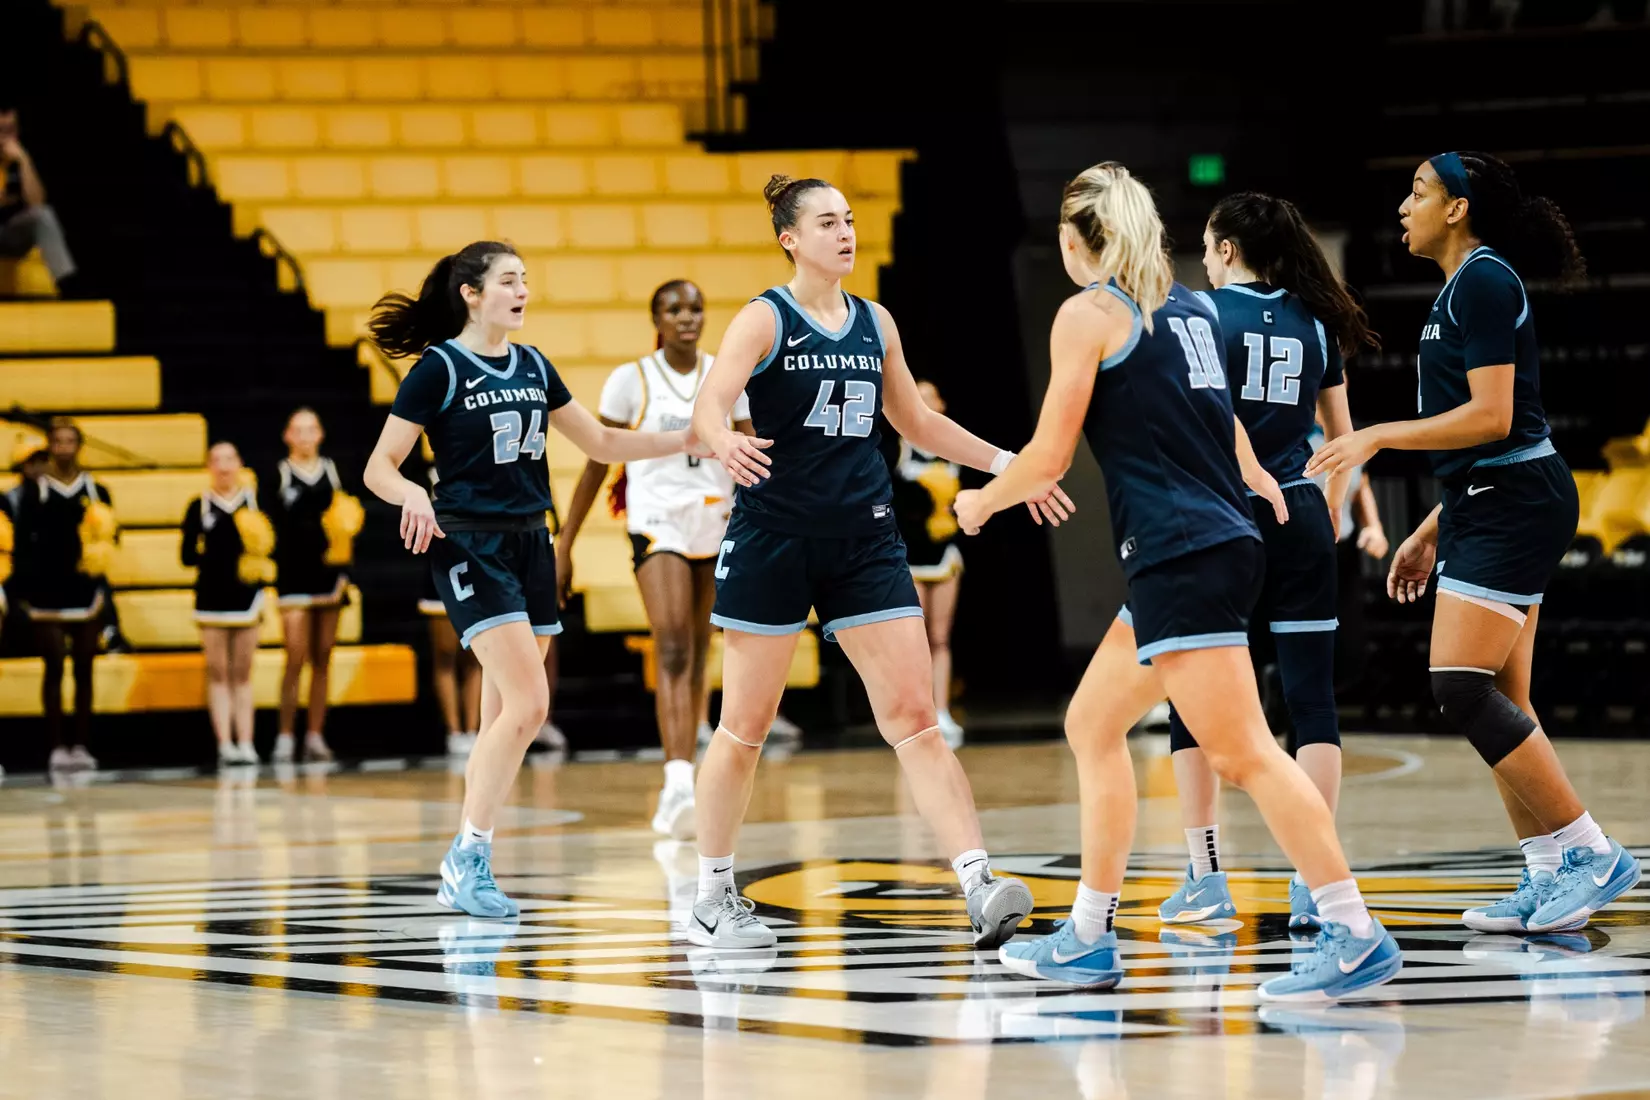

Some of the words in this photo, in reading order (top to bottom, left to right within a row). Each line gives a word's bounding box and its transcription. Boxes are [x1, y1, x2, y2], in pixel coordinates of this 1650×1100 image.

[1263, 310, 1273, 323] C
[784, 354, 882, 374] COLUMBIA
[1167, 316, 1226, 389] 10
[1241, 332, 1303, 405] 12
[803, 380, 877, 438] 42
[489, 409, 546, 464] 24
[449, 561, 475, 602] C
[714, 540, 736, 580] C
